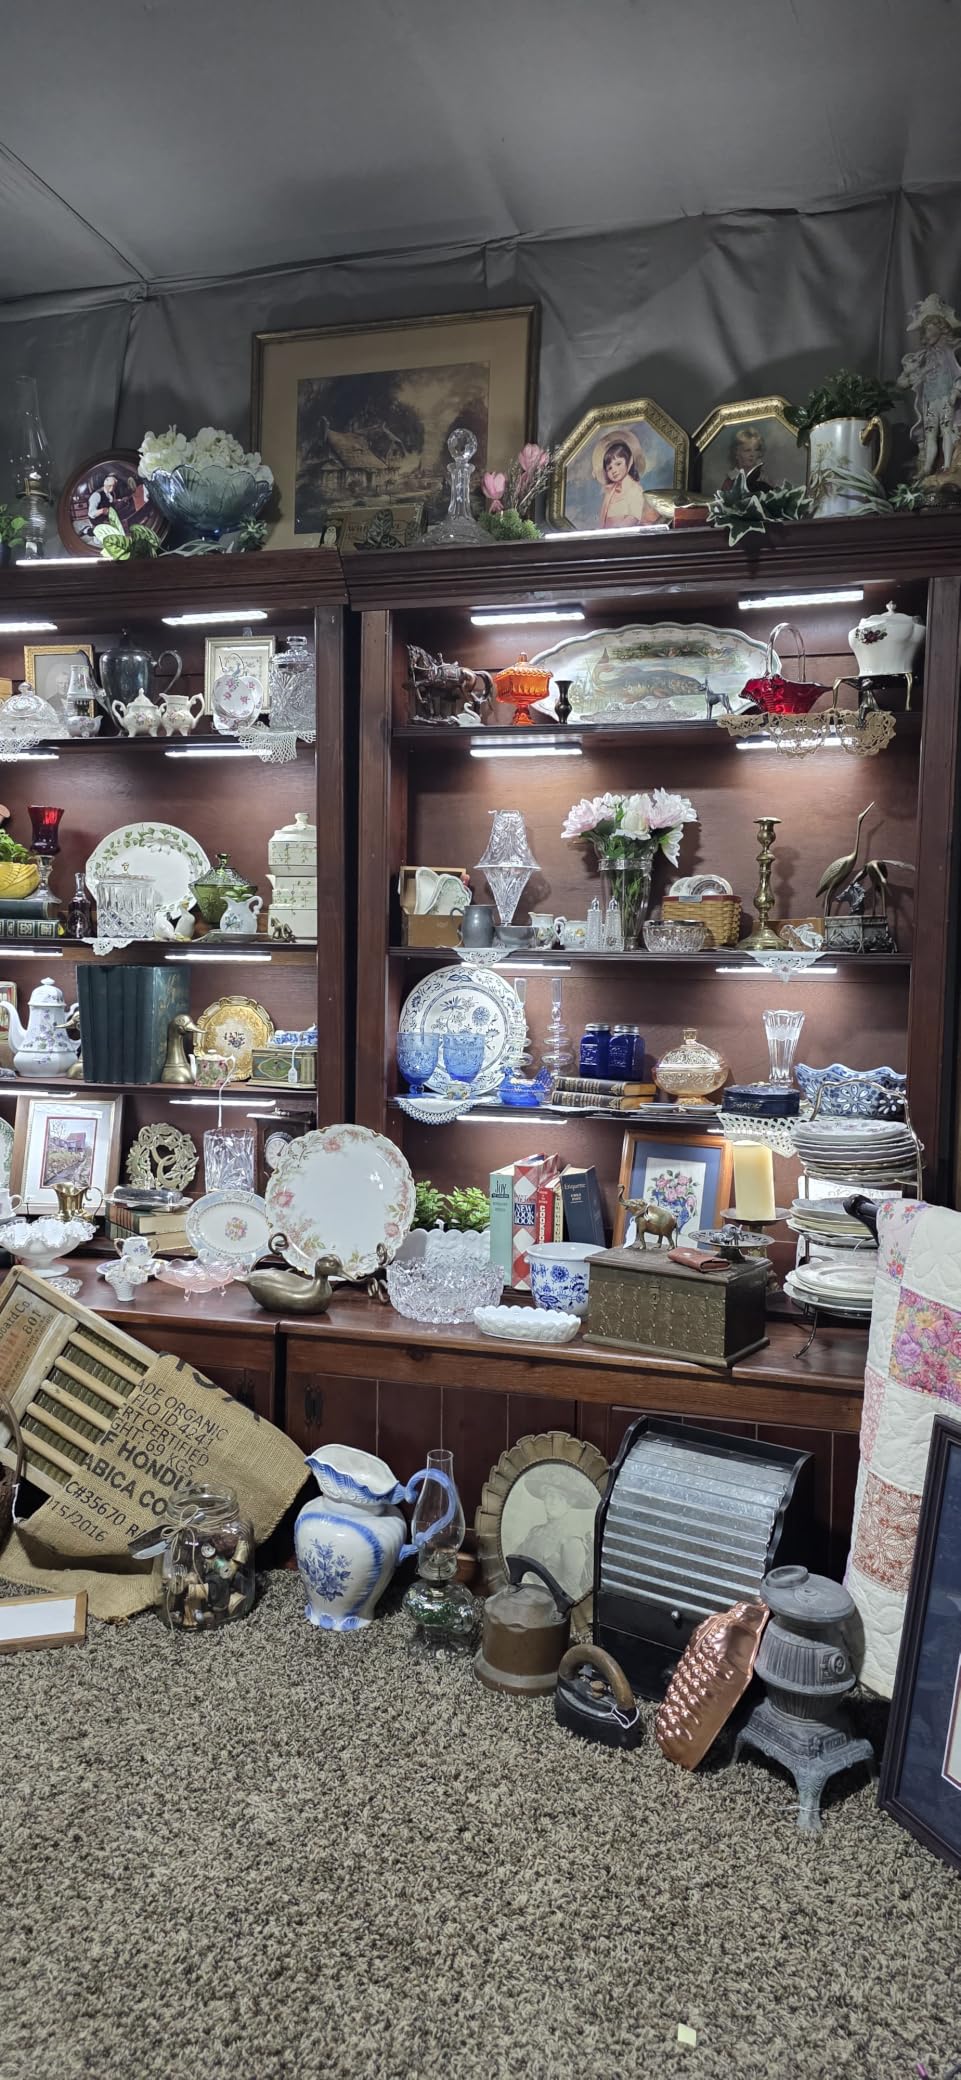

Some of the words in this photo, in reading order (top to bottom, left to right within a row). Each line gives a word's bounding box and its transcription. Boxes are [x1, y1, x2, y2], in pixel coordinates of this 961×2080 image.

[516, 1204, 534, 1212] NEW
[23, 1310, 41, 1335] 801
[131, 1394, 161, 1416] FLO
[137, 1379, 165, 1401] ADE
[164, 1396, 228, 1440] ORGANIC
[118, 1402, 144, 1424] RT
[142, 1419, 209, 1467] CERTIFIED
[81, 1453, 137, 1499] ABICA
[117, 1439, 205, 1495] HONDU
[146, 1439, 166, 1456] 69
[165, 1452, 196, 1477] KGS
[65, 1481, 126, 1525] C#35670
